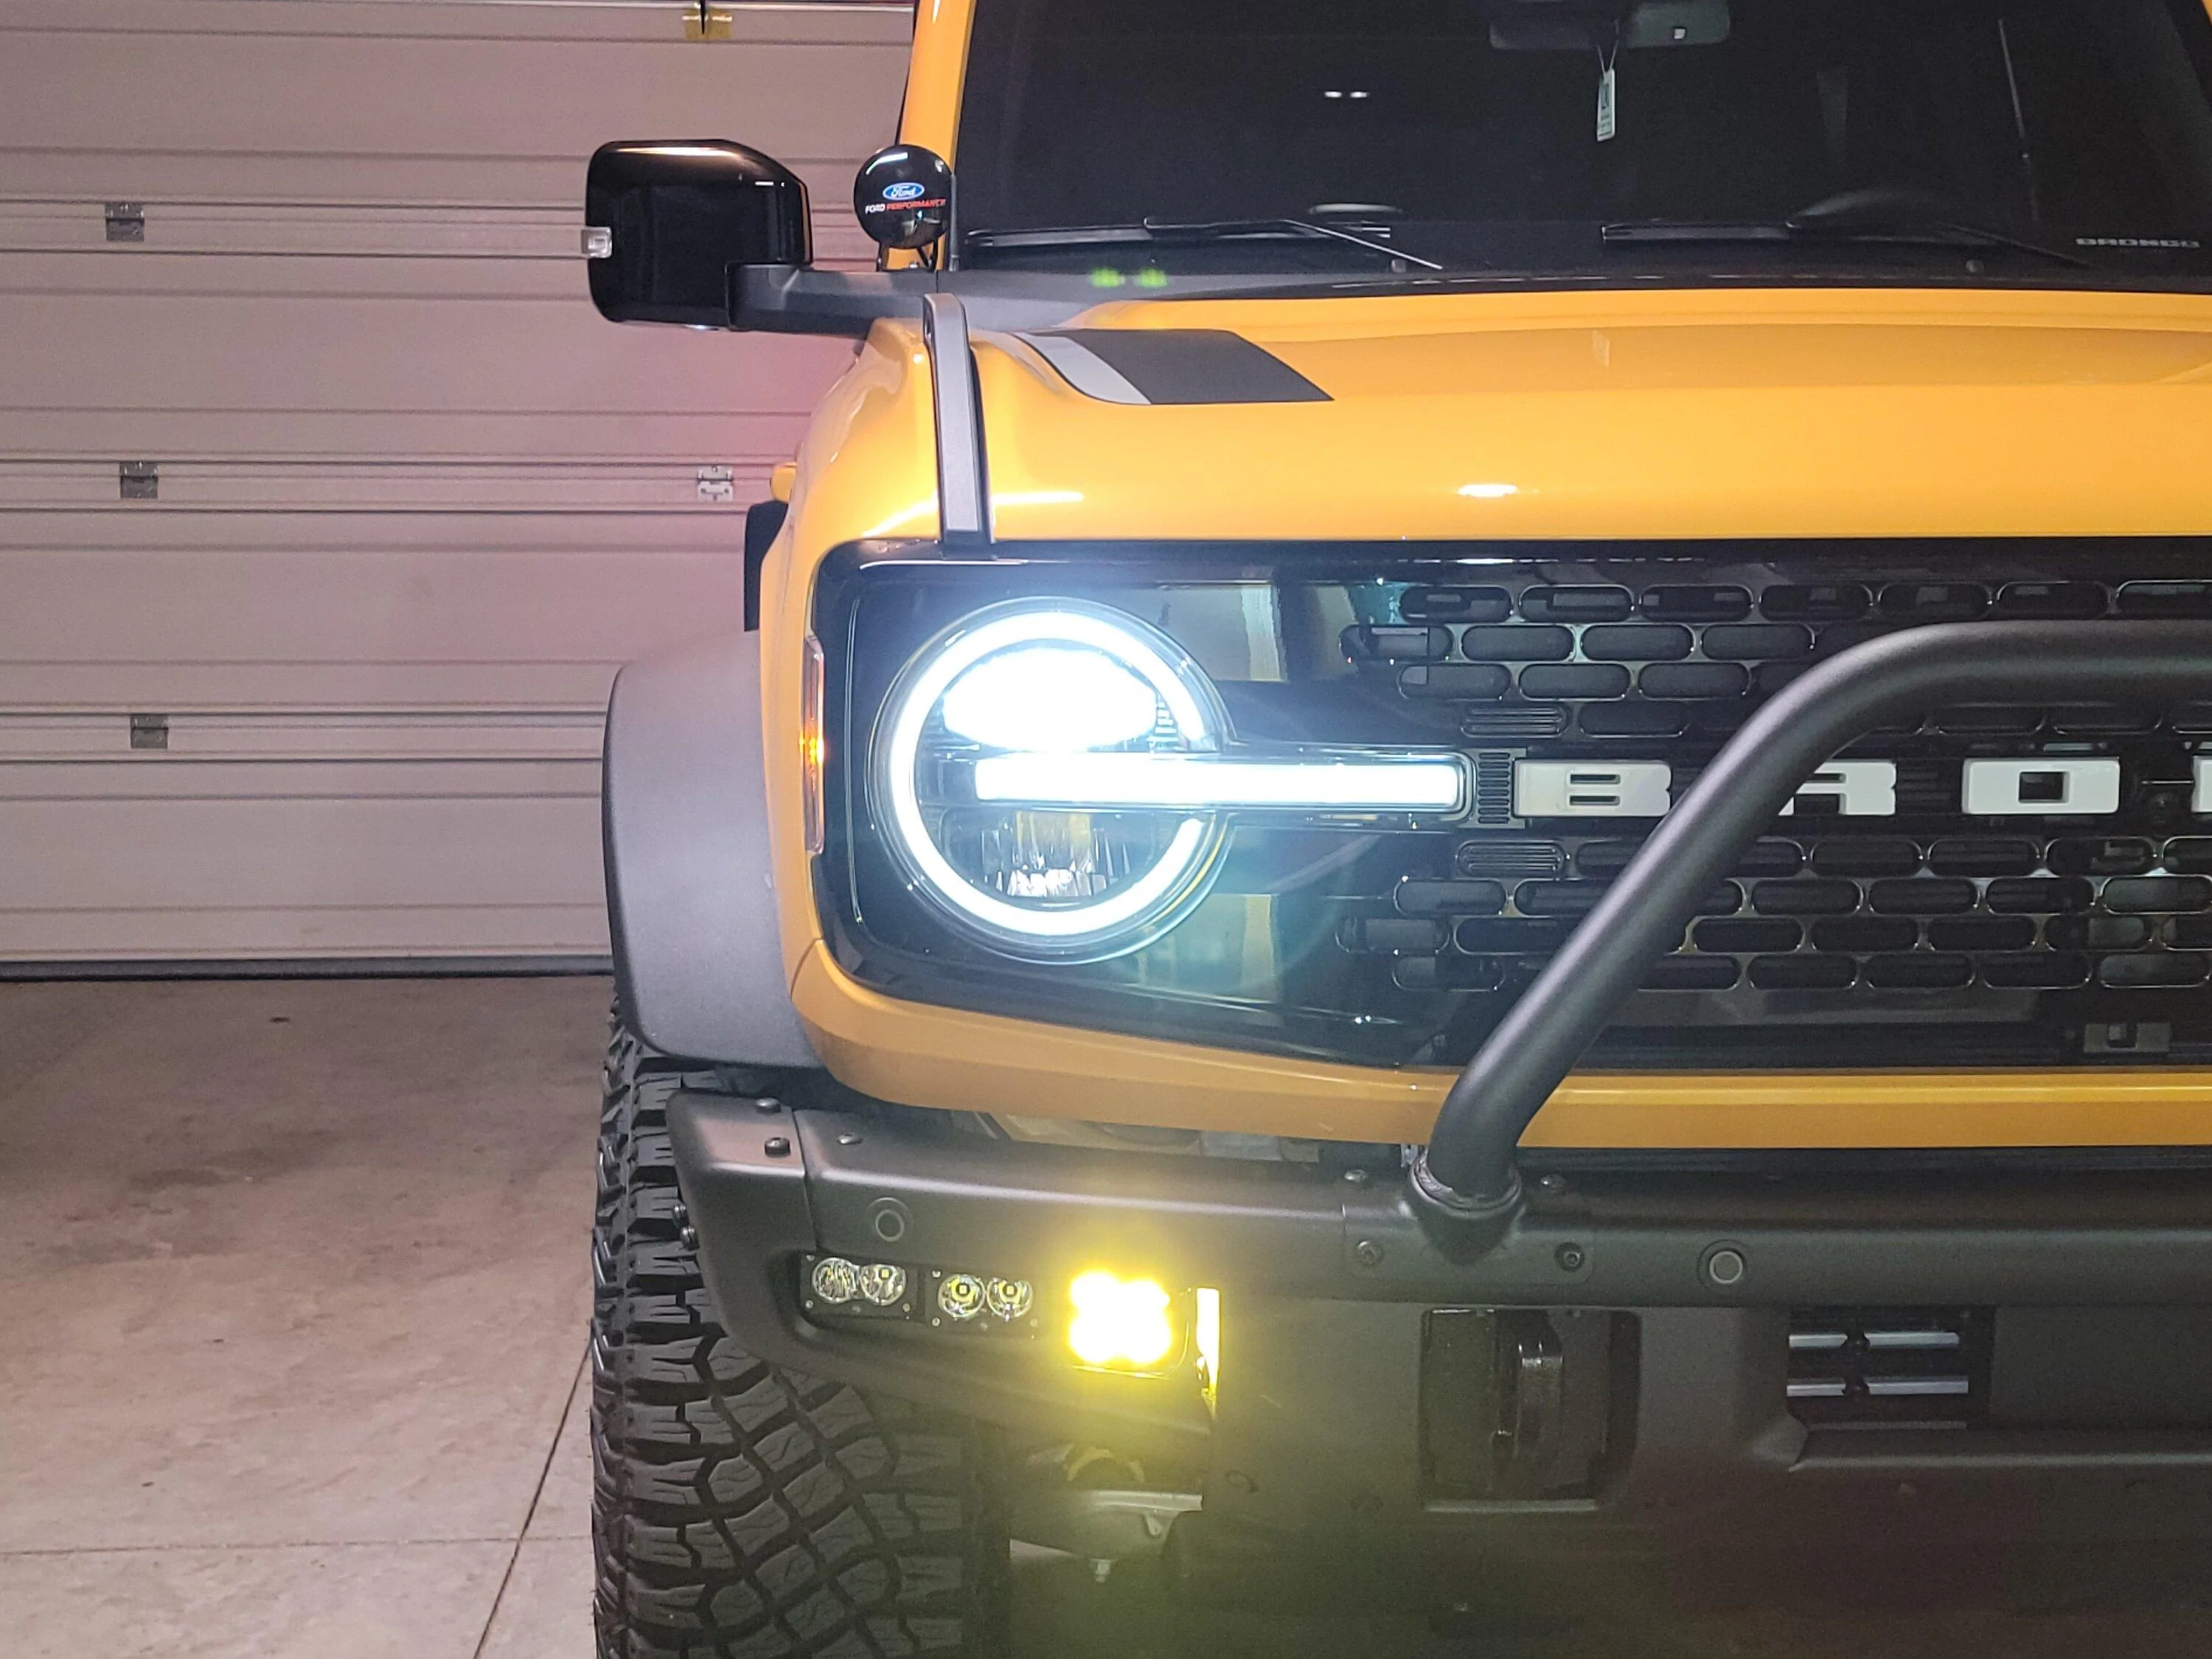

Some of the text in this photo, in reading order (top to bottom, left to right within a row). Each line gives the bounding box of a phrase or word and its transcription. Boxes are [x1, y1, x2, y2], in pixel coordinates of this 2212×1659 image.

[891, 185, 917, 198] Ford
[865, 198, 946, 215] FORD PERFORMANCE
[2076, 238, 2200, 248] BRONCO
[1514, 758, 2212, 816] BRO
